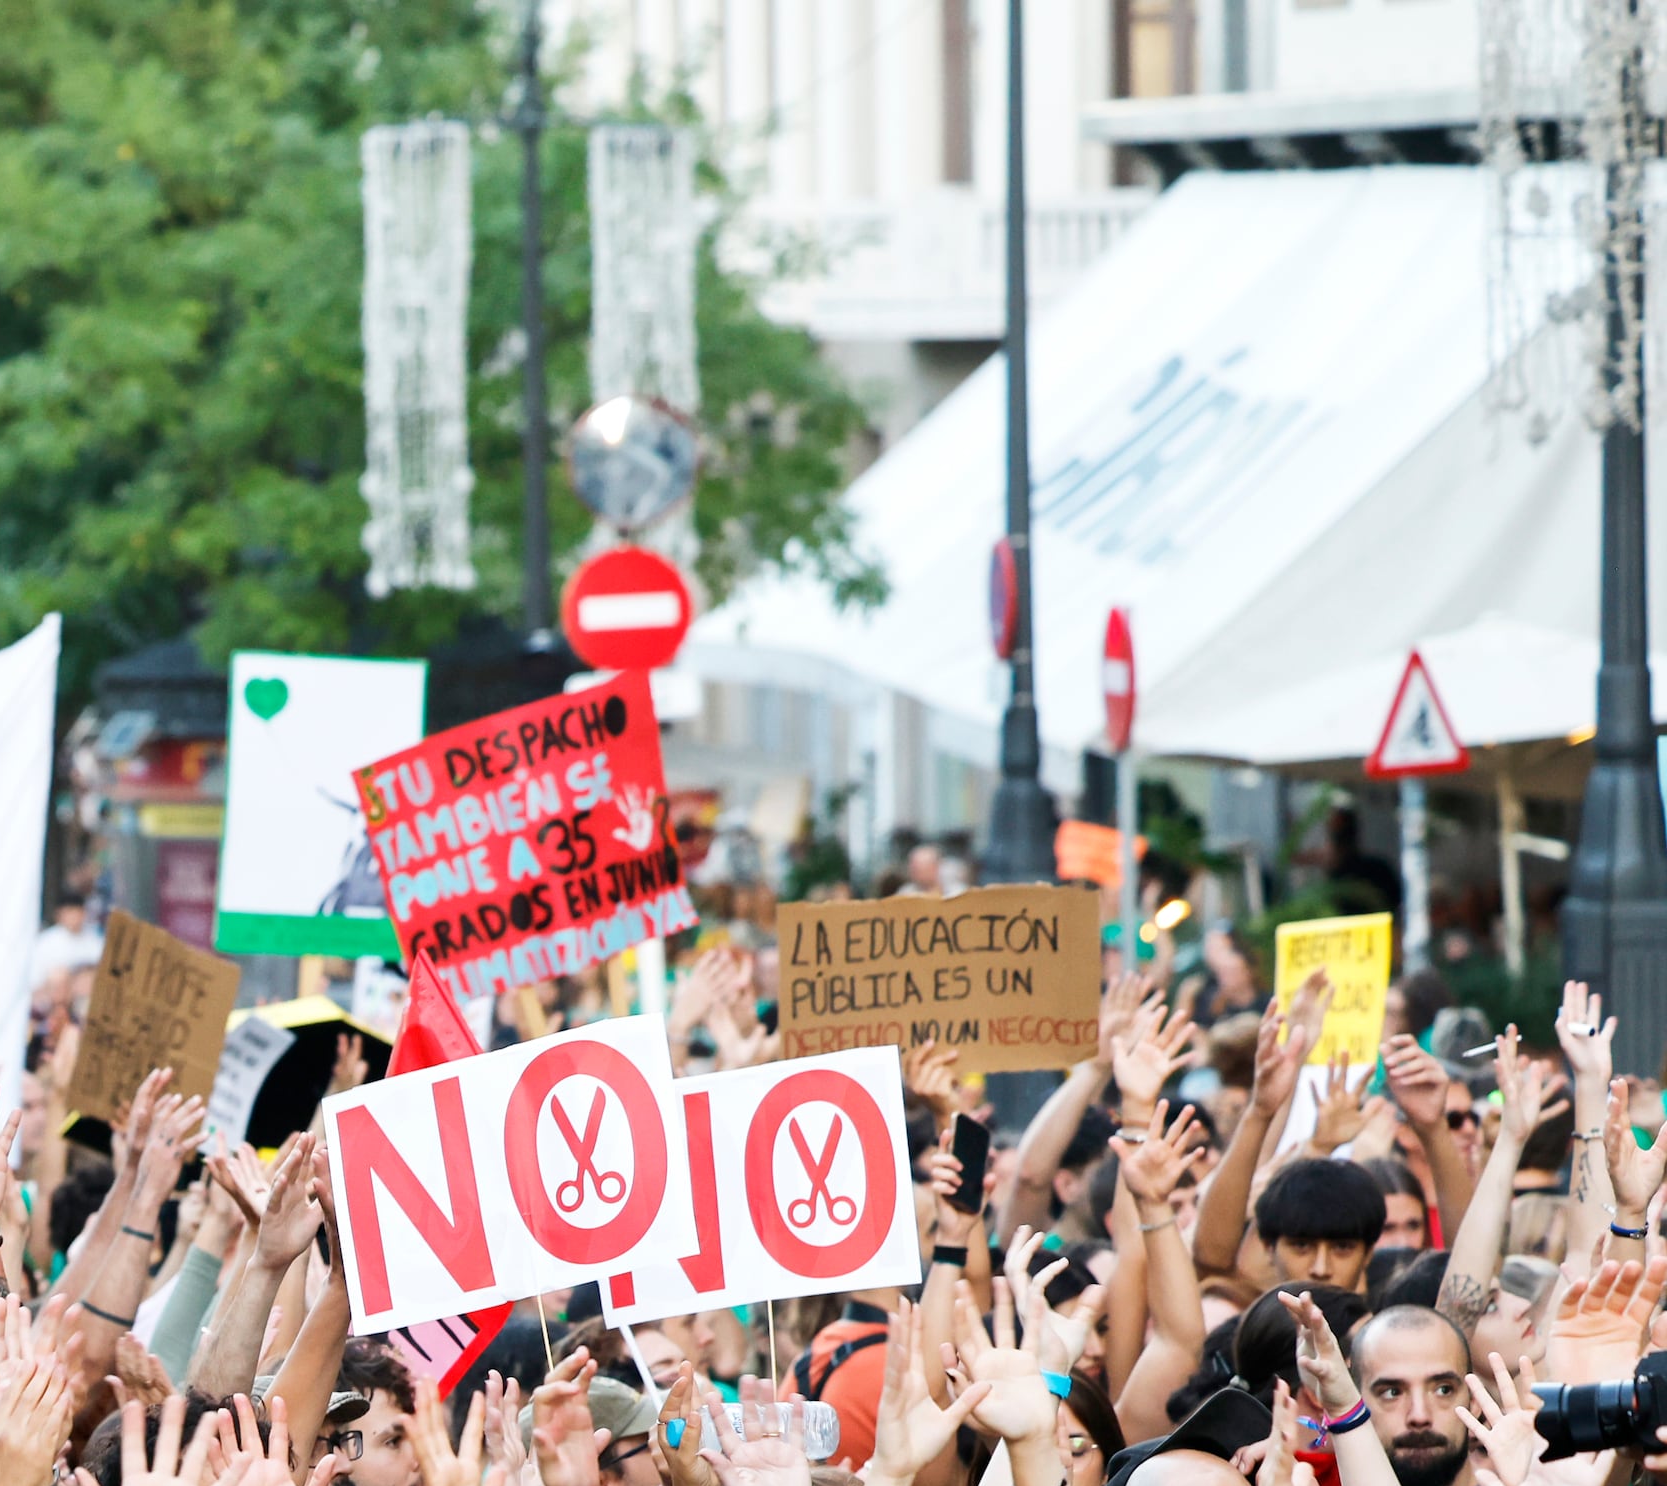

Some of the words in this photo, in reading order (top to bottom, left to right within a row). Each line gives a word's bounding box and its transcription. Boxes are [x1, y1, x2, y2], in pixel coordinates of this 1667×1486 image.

[444, 695, 627, 788] DESPACHO
[374, 768, 562, 873] TAMBIÉN
[566, 752, 614, 810] SE
[389, 845, 497, 922] PONE
[508, 836, 542, 881] A
[537, 811, 597, 876] 35
[409, 883, 554, 965] GRADOS
[563, 873, 601, 920] EN
[791, 920, 832, 967] LA
[844, 908, 1058, 965] EDUCACIÓN
[791, 971, 923, 1020] PÚBLICA
[933, 966, 971, 1001] ES
[986, 967, 1033, 996] UN
[910, 1019, 940, 1046] NO
[946, 1019, 979, 1044] UN
[988, 1015, 1100, 1047] NEGOCIO
[335, 1039, 668, 1317] NO
